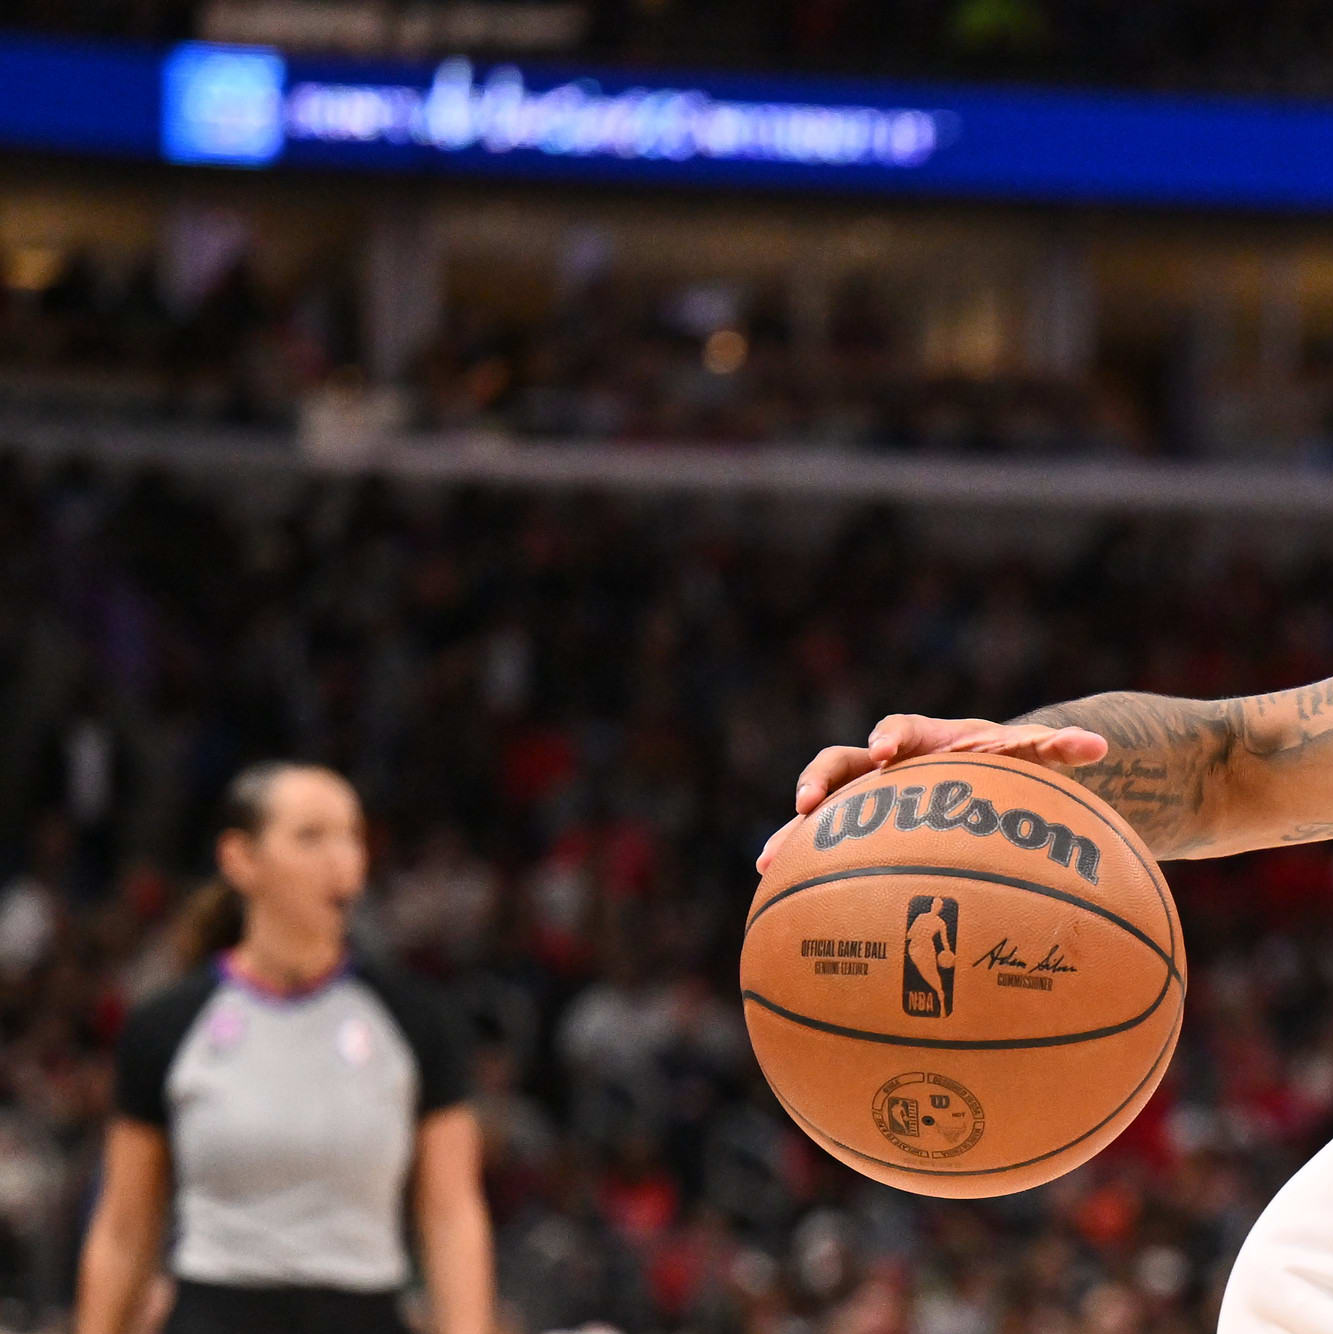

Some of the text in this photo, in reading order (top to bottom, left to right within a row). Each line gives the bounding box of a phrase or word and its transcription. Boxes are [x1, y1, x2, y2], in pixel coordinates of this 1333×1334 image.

[813, 779, 1101, 885] Wilson
[801, 939, 888, 960] OFFICIAL GAME BALL
[908, 990, 934, 1012] NBA
